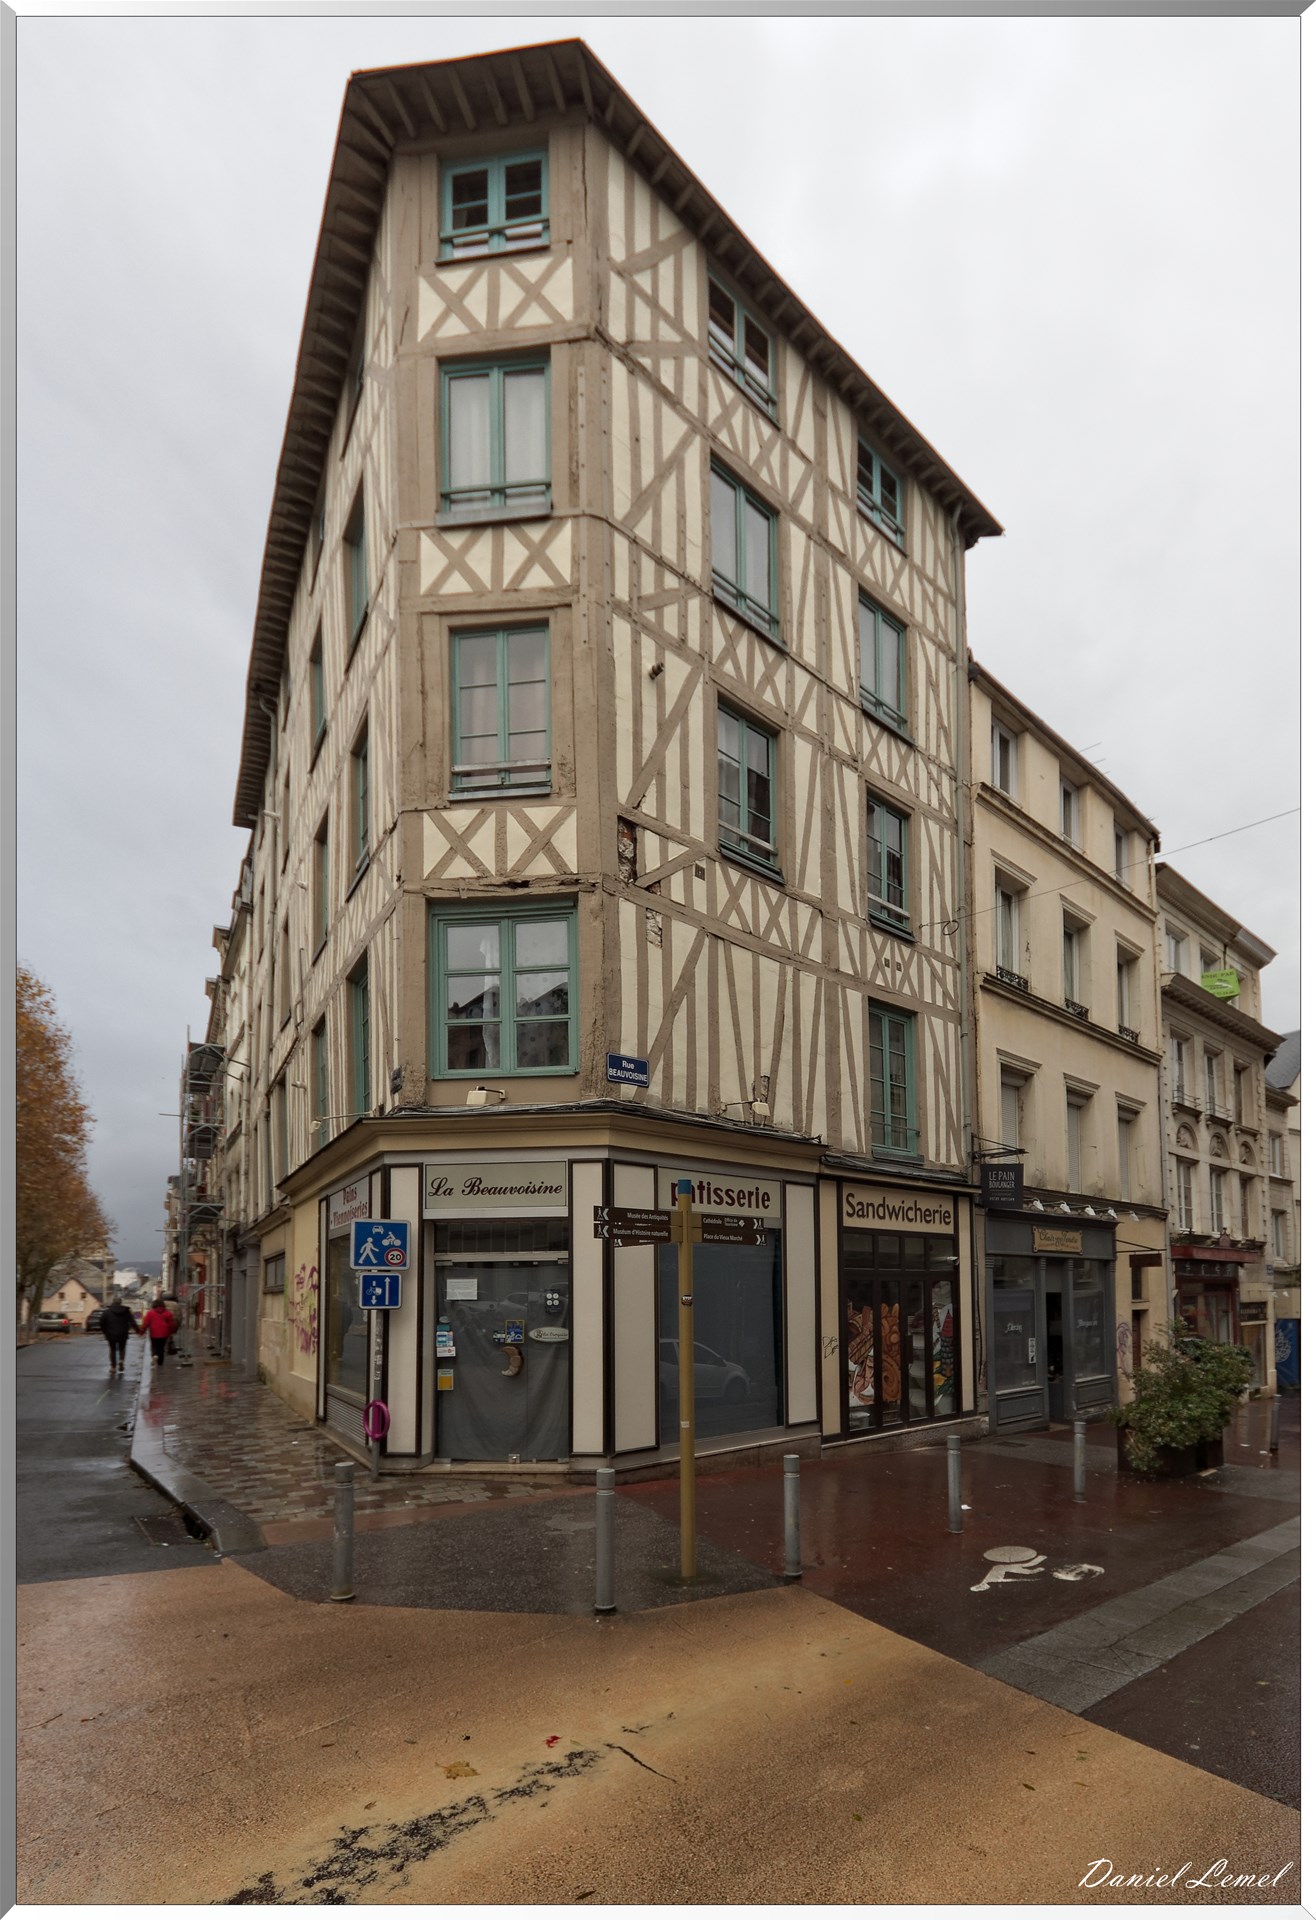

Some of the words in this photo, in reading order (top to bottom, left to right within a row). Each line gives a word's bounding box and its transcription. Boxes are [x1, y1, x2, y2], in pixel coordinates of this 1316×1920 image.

[622, 1060, 635, 1070] Rue
[609, 1068, 648, 1082] BEAUVOISINE
[989, 1171, 997, 1181] LE
[998, 1171, 1015, 1181] PAIN
[428, 1177, 454, 1197] La
[461, 1176, 563, 1196] Beauvoisine
[989, 1181, 1015, 1189] BOULANGER
[846, 1192, 952, 1226] Sandwicherie
[649, 1213, 669, 1221] Antiquités
[703, 1217, 722, 1225] Cathédrale
[613, 1228, 631, 1236] Muséum
[632, 1228, 651, 1236] d'Histoire
[389, 1253, 402, 1261] 20
